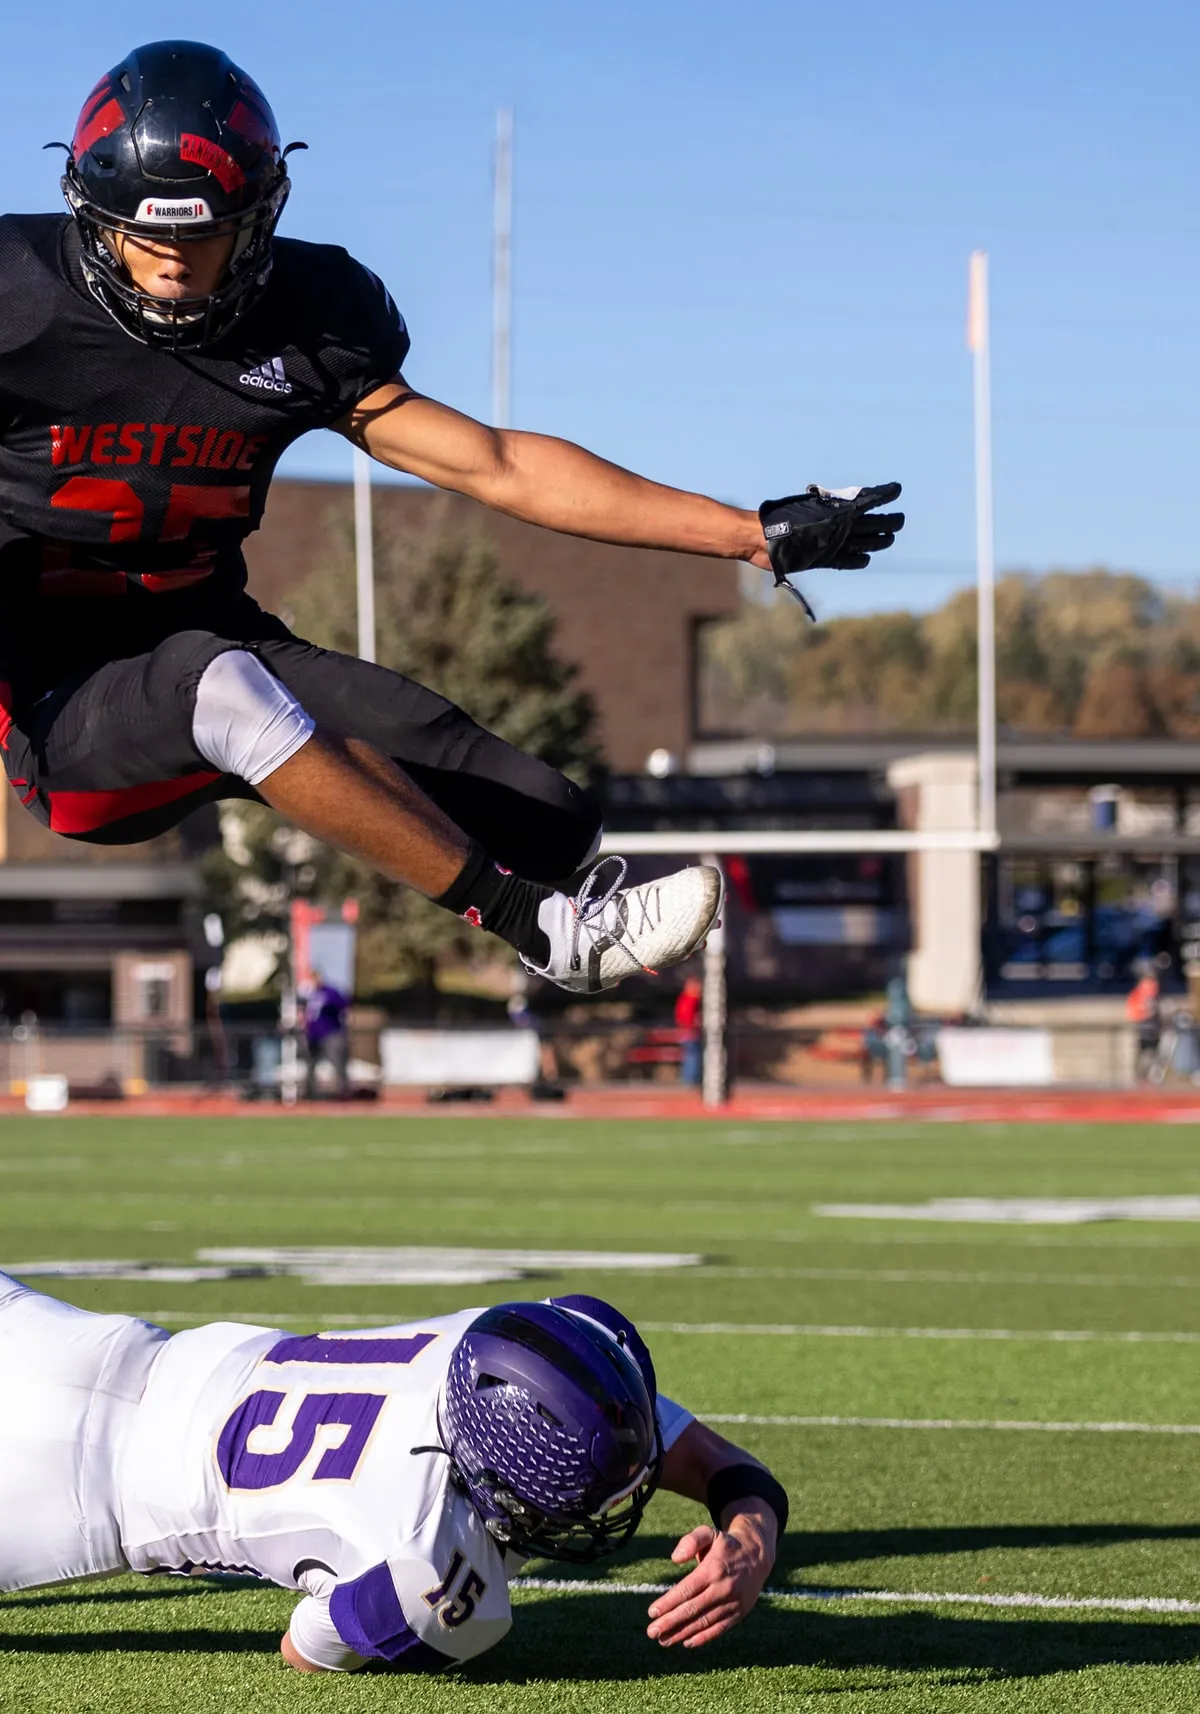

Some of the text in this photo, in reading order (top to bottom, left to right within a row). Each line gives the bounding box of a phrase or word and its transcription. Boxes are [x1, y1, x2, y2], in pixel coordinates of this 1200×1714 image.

[154, 206, 193, 217] WARRIORS
[239, 374, 293, 394] adidas
[49, 423, 268, 470] WESTSIDE
[212, 1331, 445, 1496] 15
[420, 1548, 490, 1633] 15
